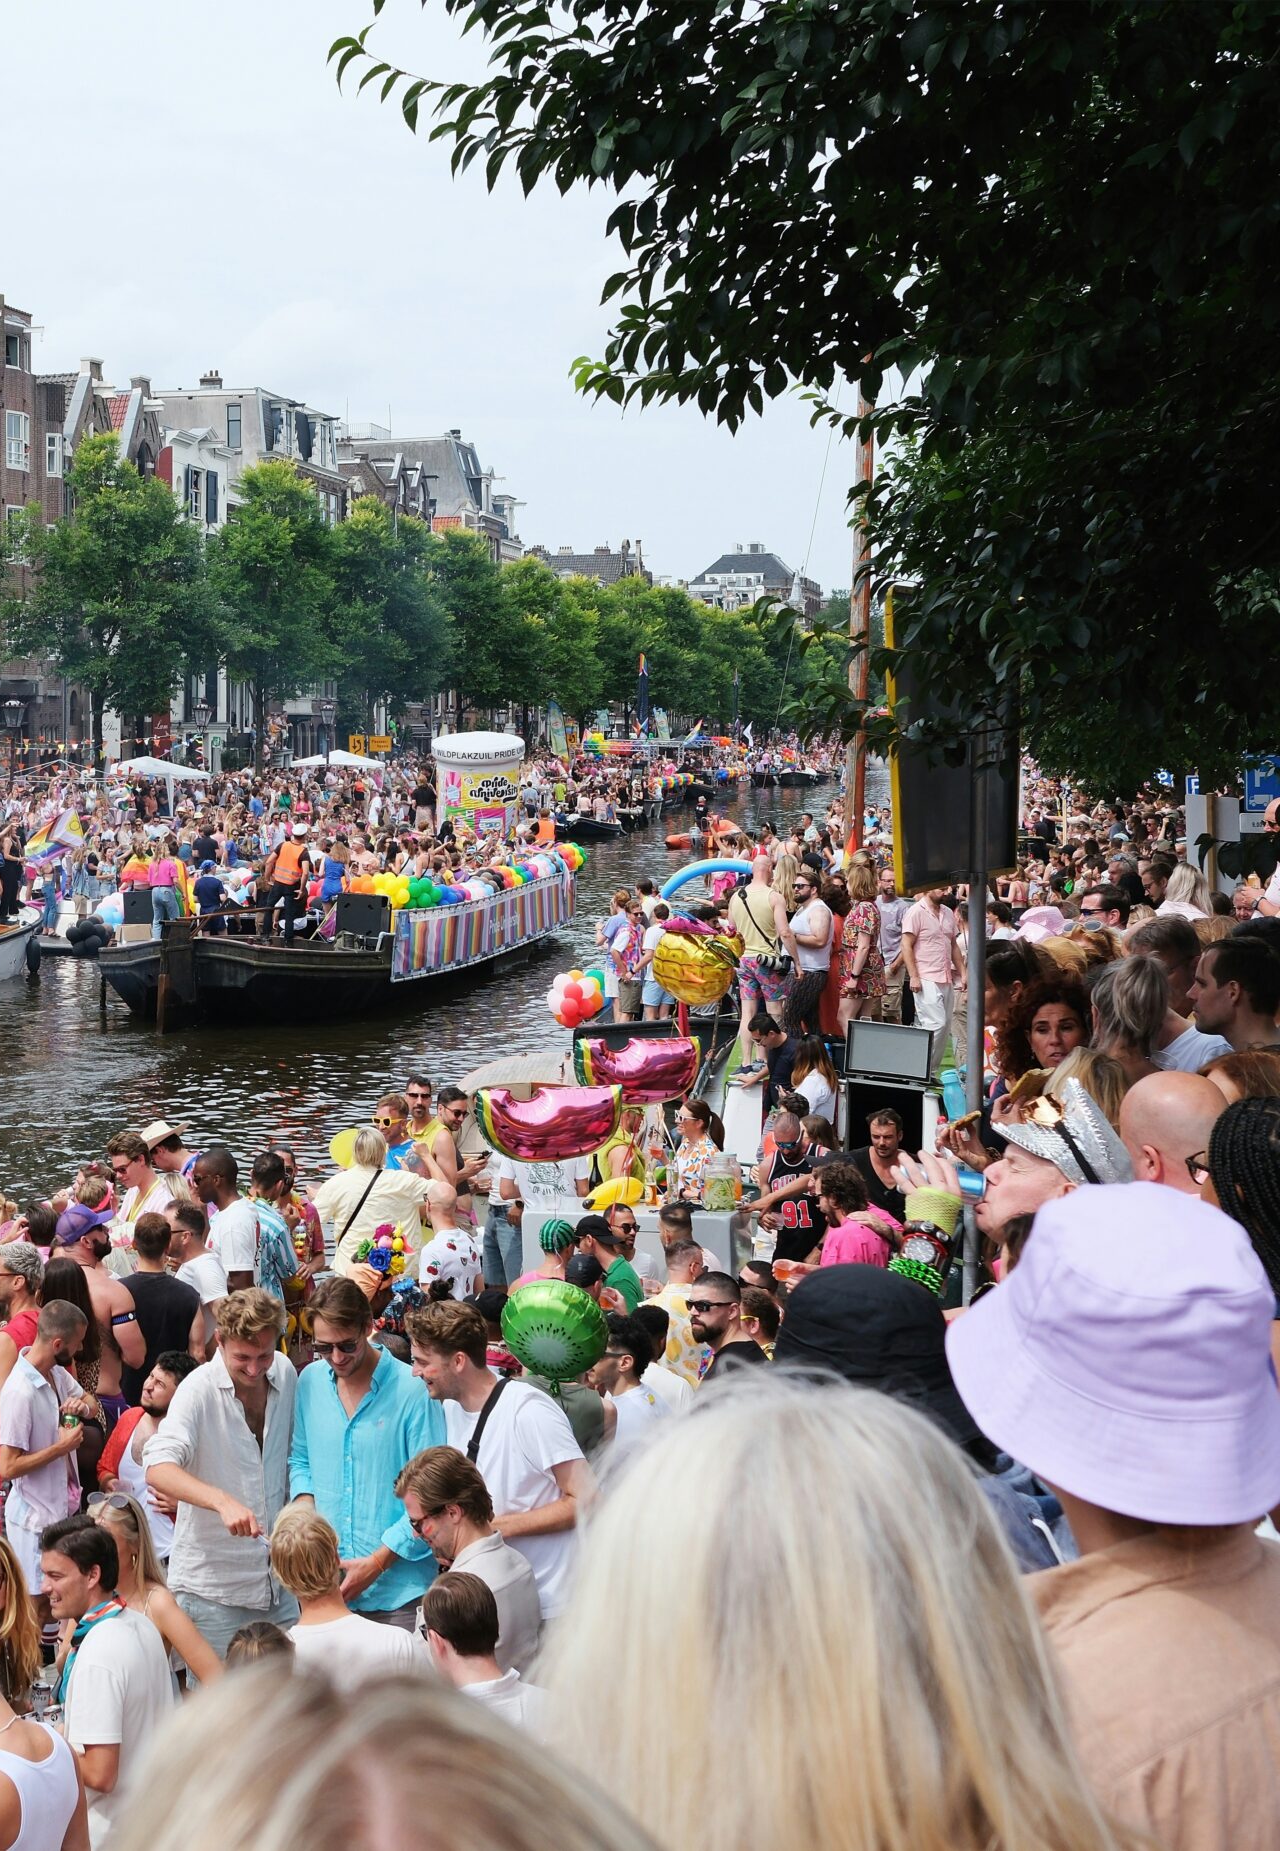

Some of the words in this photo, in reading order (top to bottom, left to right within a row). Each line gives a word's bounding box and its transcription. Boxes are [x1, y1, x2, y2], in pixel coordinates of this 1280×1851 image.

[436, 749, 493, 760] WILDPLAKZUIL
[494, 749, 516, 759] PRIDE
[481, 776, 508, 789] Pride
[781, 1199, 813, 1229] 91
